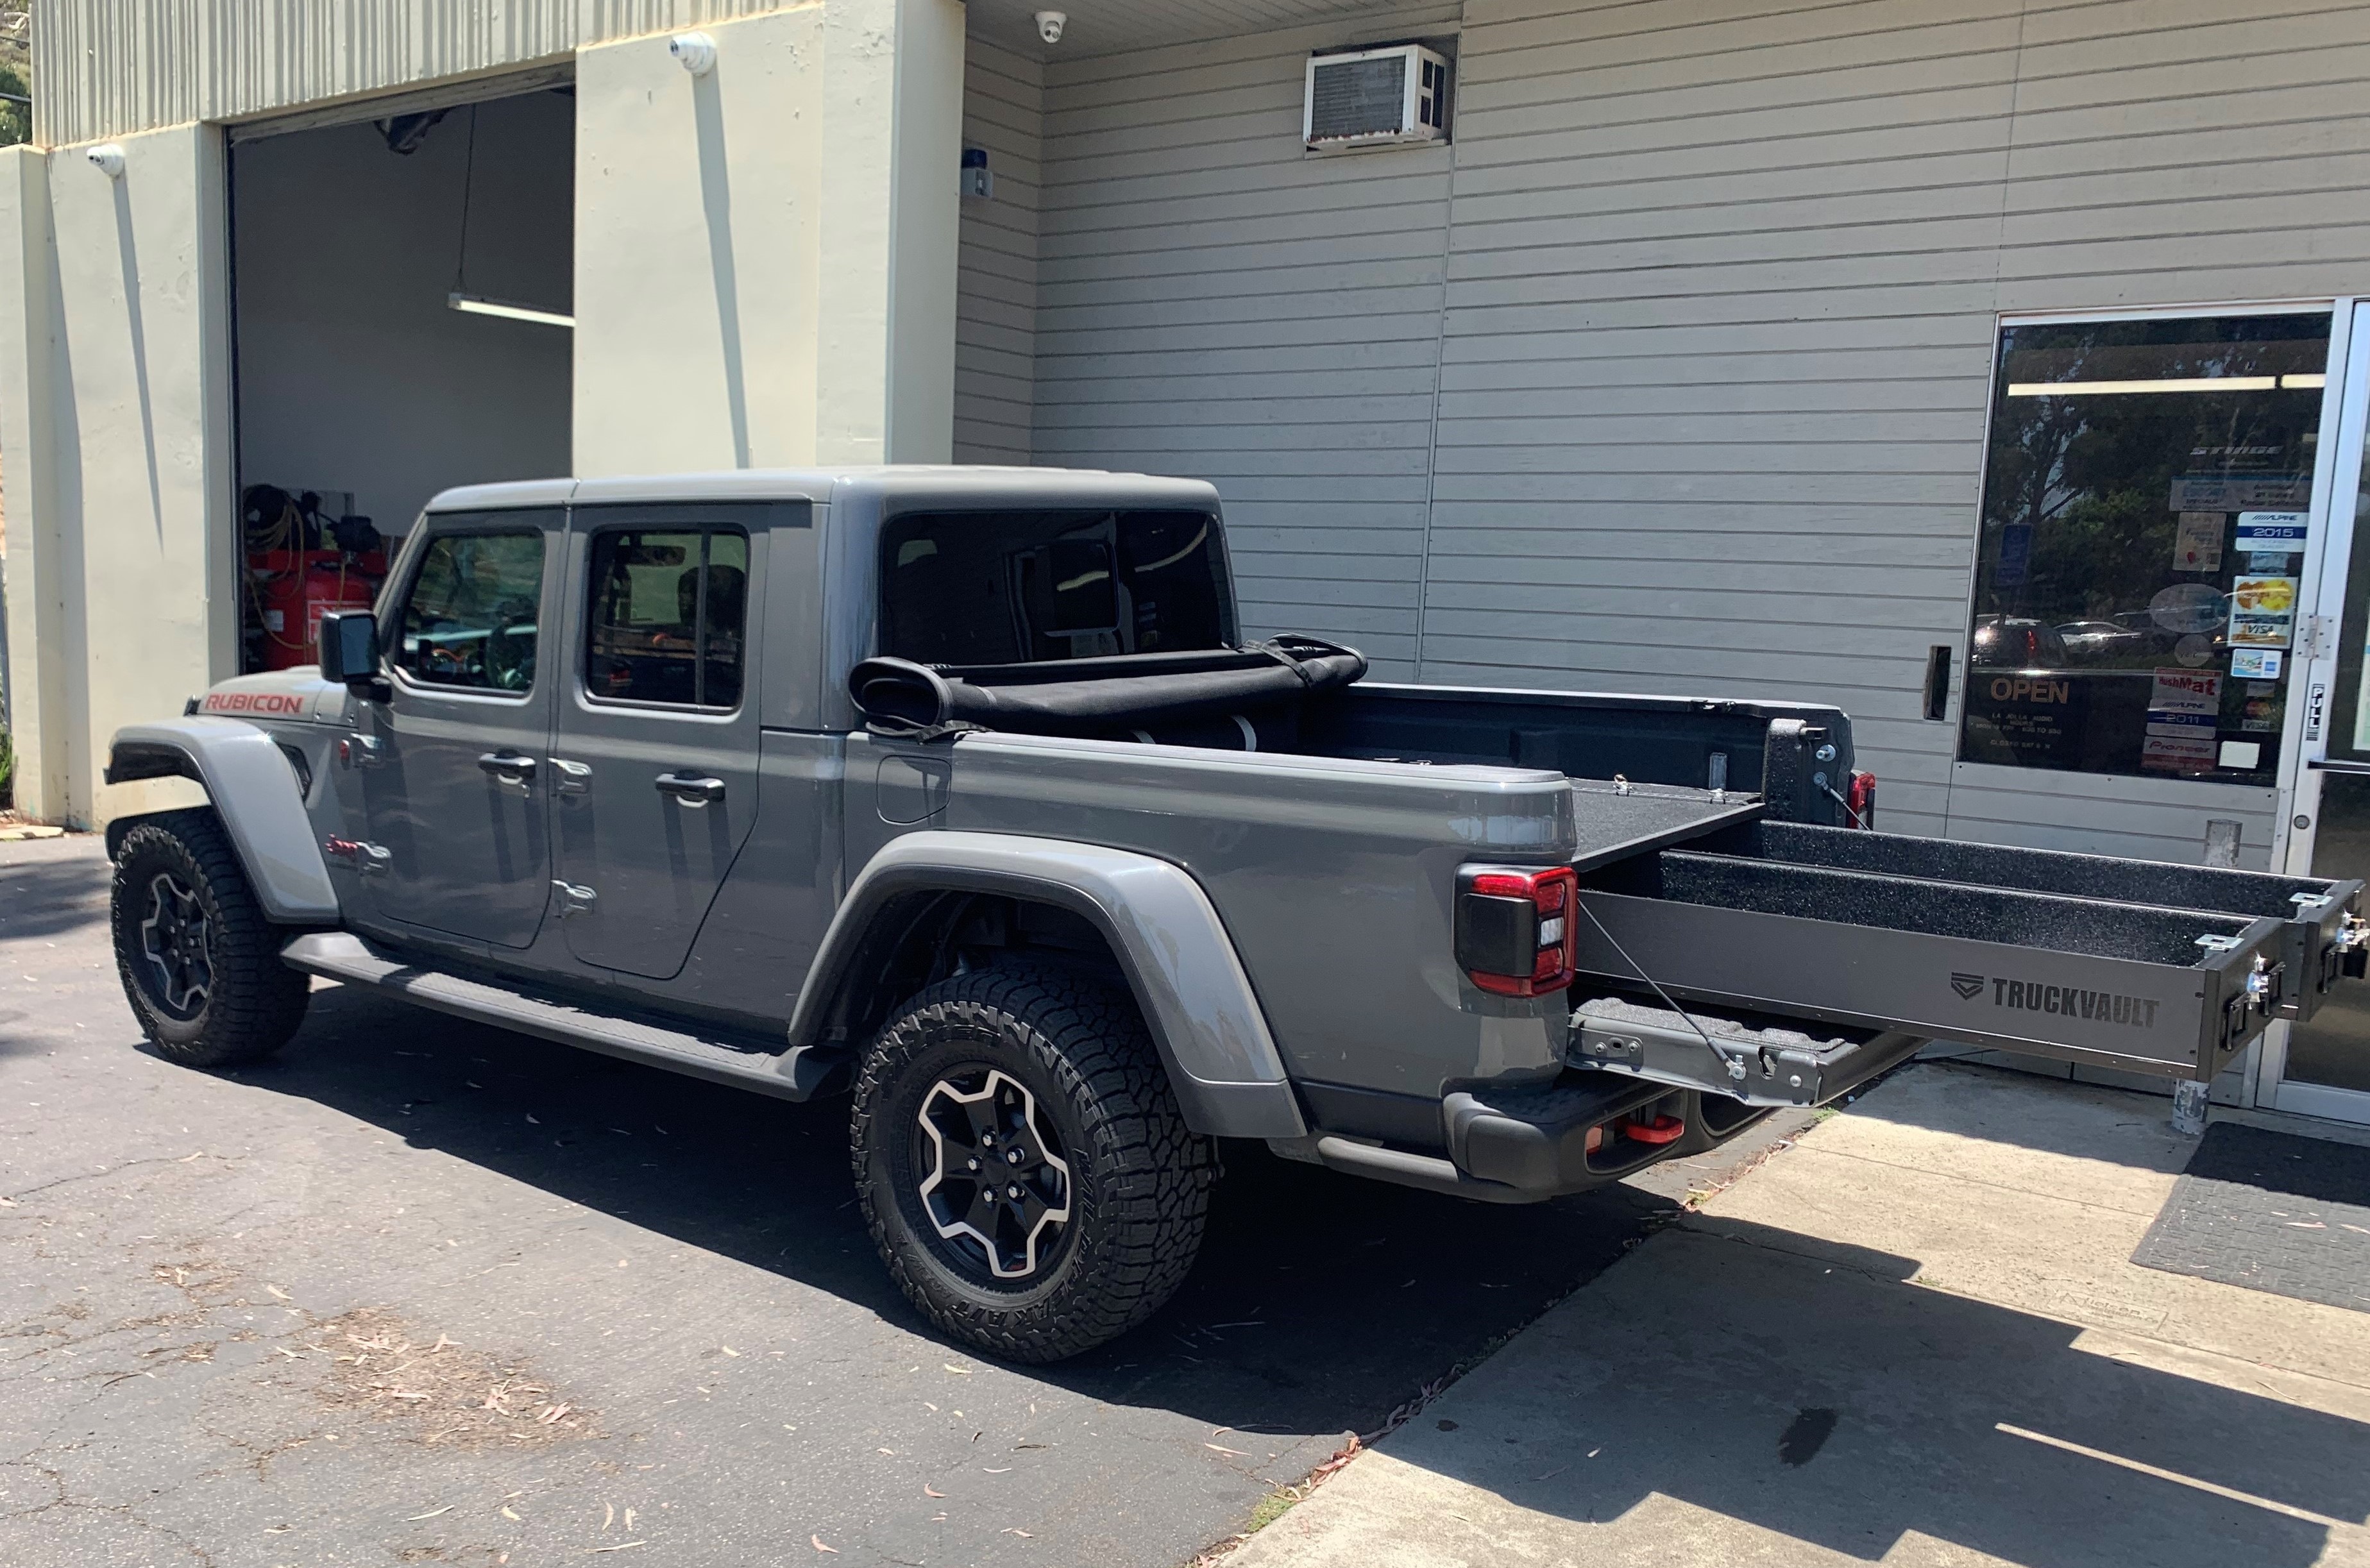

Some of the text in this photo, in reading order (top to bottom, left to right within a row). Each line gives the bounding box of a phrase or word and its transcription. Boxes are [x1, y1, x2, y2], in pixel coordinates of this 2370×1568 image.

[2247, 625, 2274, 634] VISA
[1990, 677, 2070, 704] OPEN
[2158, 675, 2217, 696] HushMat
[205, 693, 304, 714] RUBICON
[2174, 701, 2206, 709] ALPINE
[2310, 687, 2324, 728] PULL
[2166, 714, 2199, 725] 2011
[2149, 740, 2211, 754] Pioneer
[1992, 977, 2160, 1028] TRUCKVAULT
